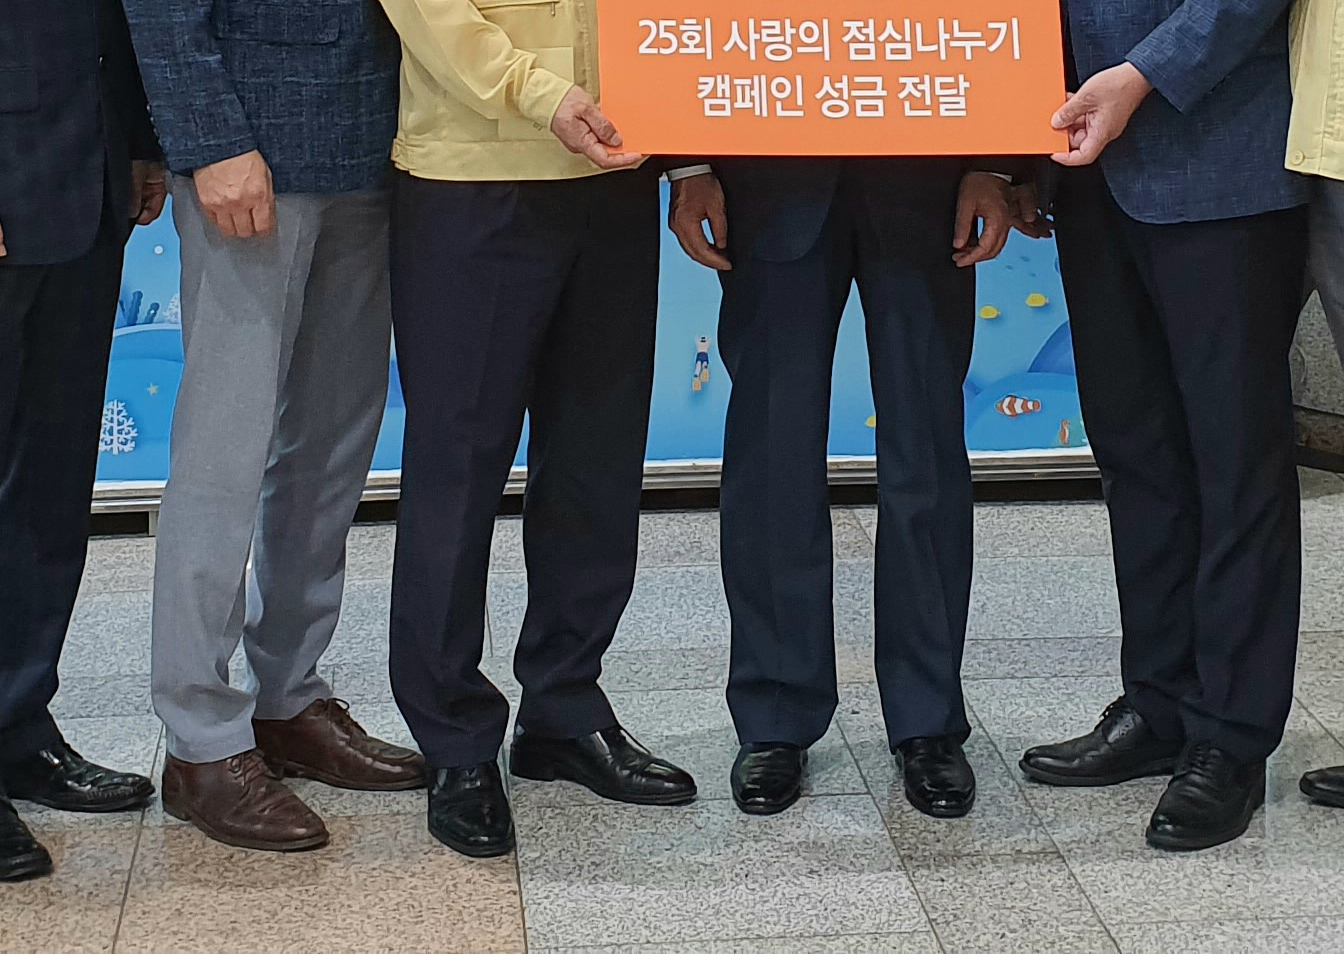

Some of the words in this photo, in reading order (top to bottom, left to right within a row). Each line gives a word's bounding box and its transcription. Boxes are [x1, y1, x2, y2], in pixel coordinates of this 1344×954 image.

[637, 18, 713, 60] 25회
[722, 18, 831, 62] 사랑의
[841, 17, 1022, 61] 점심나누기
[697, 74, 804, 118] 캠페인
[814, 75, 887, 119] 성금
[897, 74, 970, 118] 전달
